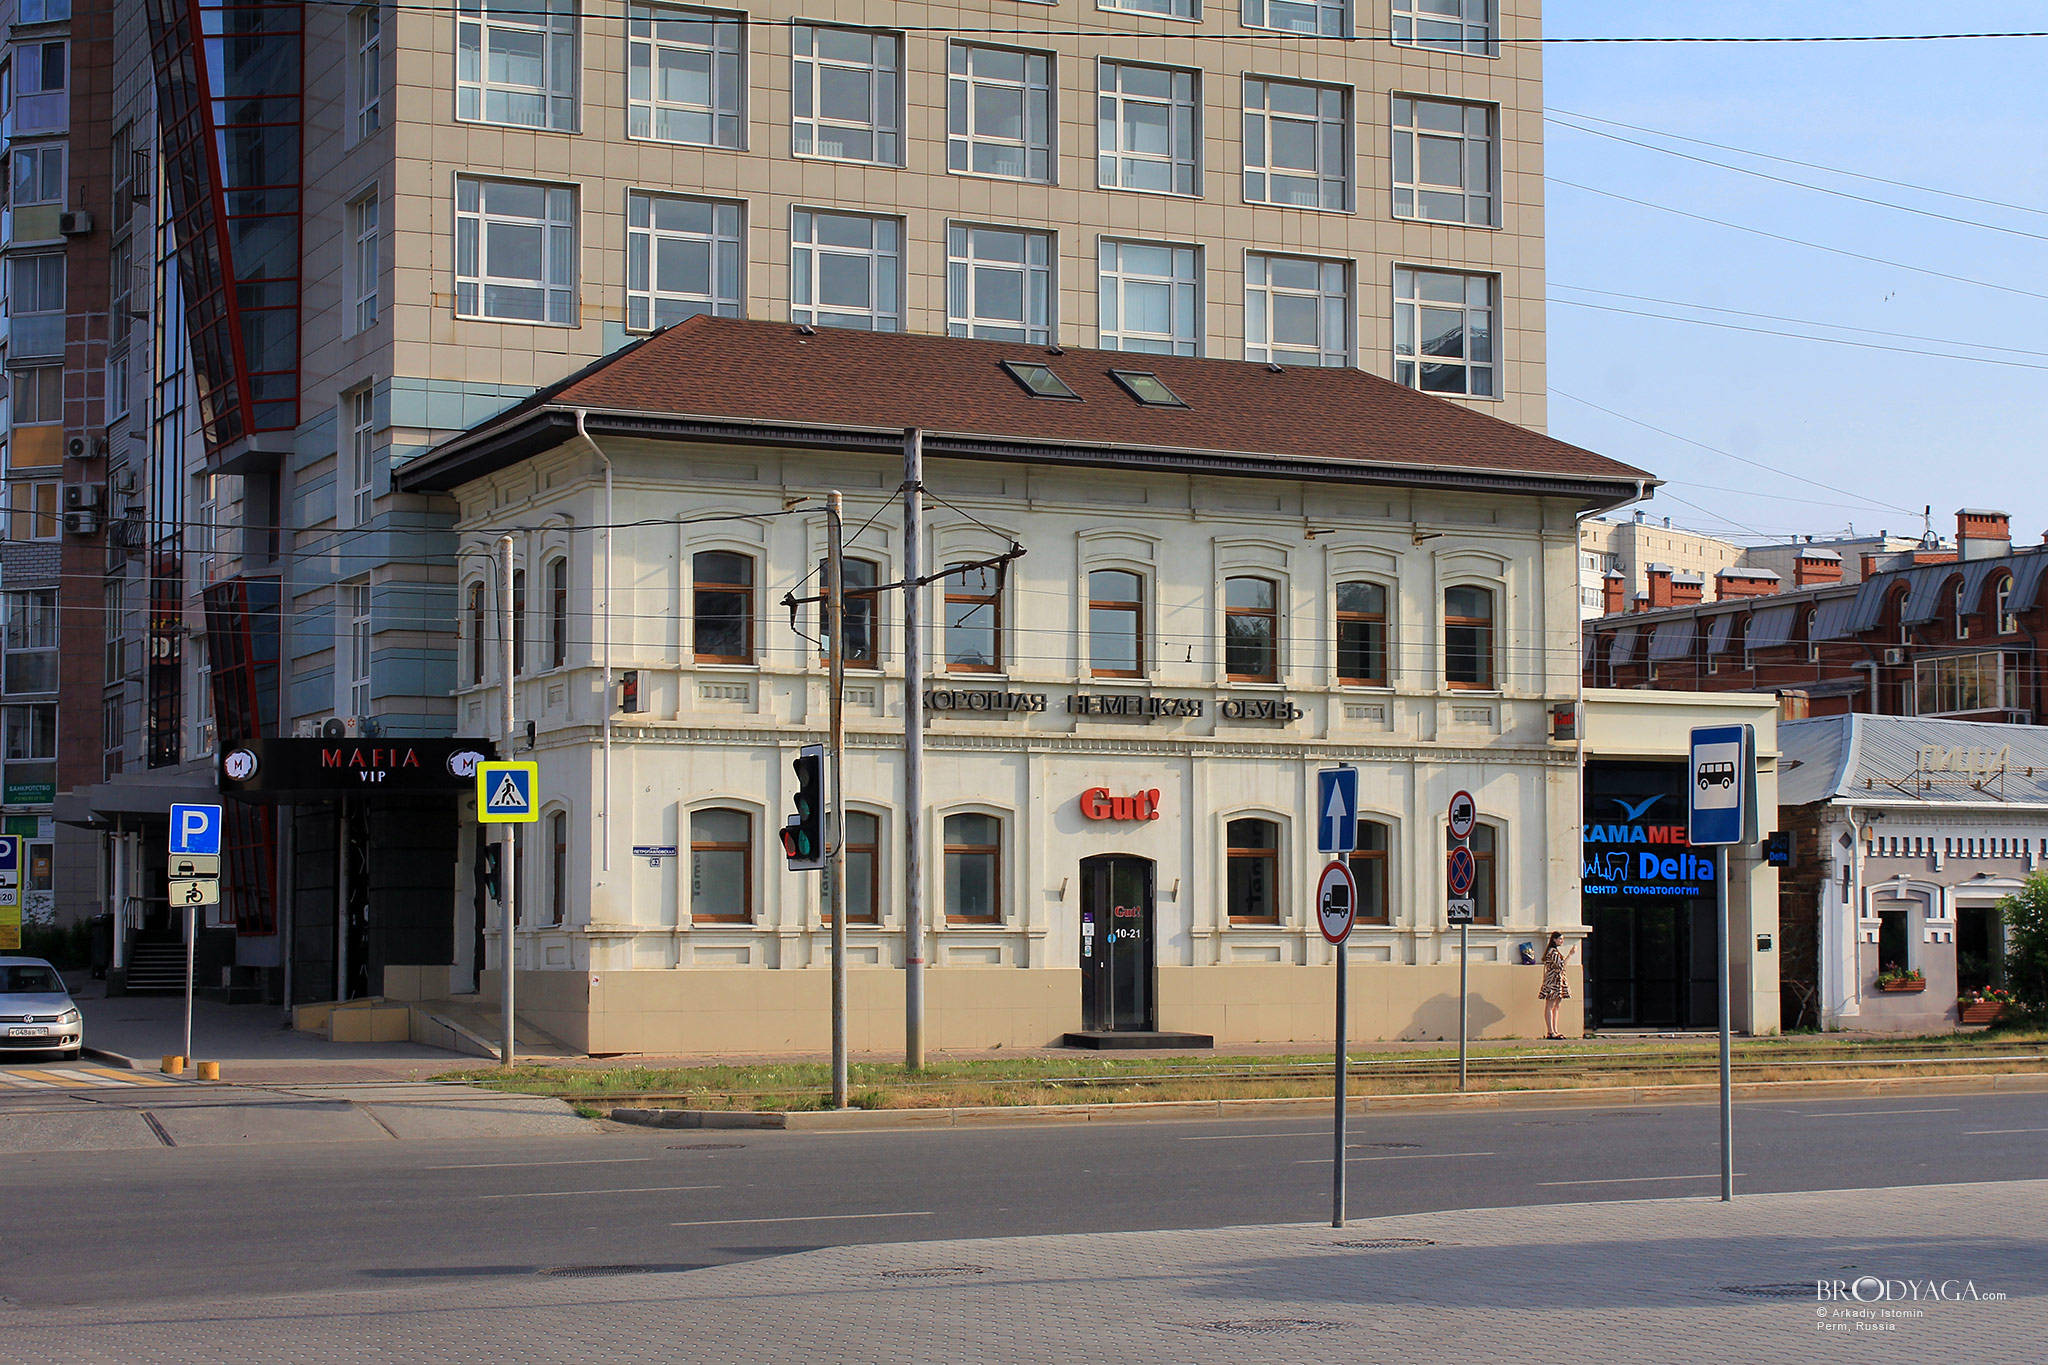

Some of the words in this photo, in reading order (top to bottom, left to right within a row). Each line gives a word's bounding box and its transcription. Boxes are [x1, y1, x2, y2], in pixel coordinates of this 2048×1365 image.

[1067, 694, 1203, 720] НЕМЕЦКАЯ
[1222, 700, 1304, 720] ОБУВЬ
[322, 748, 420, 768] MAFIA
[1919, 744, 2010, 780] ПИЦЦА
[359, 771, 386, 782] VIP
[1080, 787, 1160, 821] Gut!
[181, 810, 209, 848] P
[1583, 824, 1692, 848] АМАМЕ
[1640, 852, 1714, 880] Delta
[1584, 885, 1618, 894] центр
[1622, 885, 1699, 895] стоматологии
[1114, 905, 1141, 918] Gut!
[1115, 928, 1141, 938] 10-21
